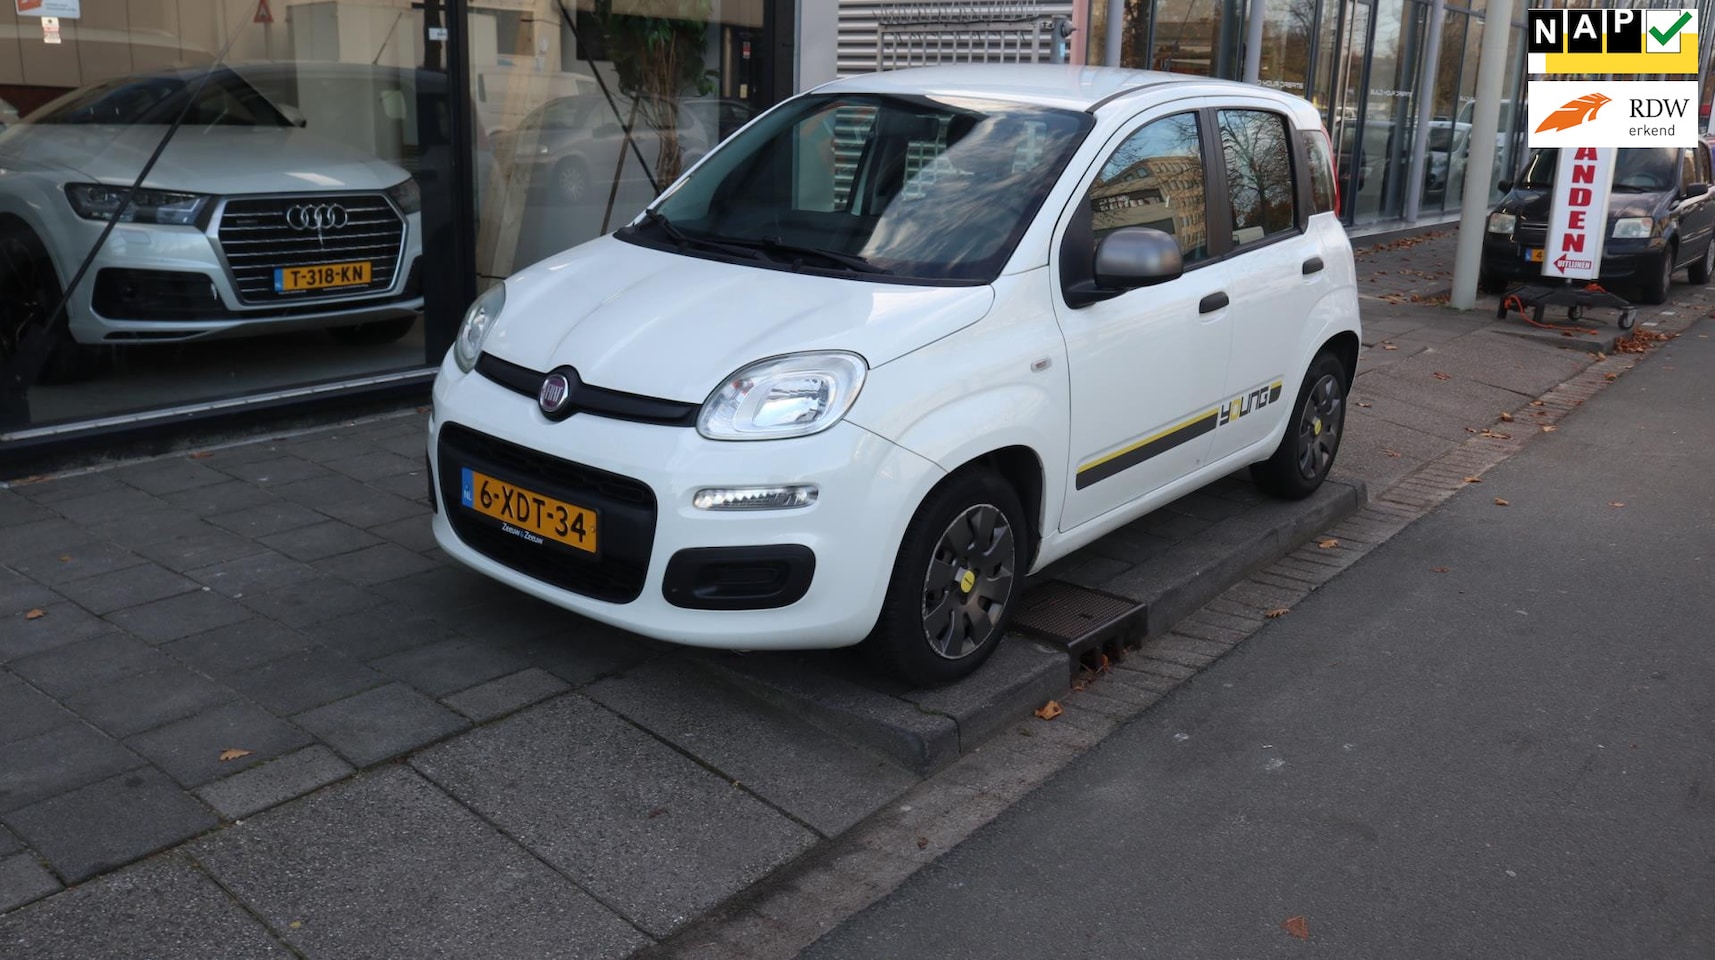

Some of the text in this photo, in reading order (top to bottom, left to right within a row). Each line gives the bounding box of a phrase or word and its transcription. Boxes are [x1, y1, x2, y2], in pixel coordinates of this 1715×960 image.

[290, 265, 363, 287] T-318-KN
[1219, 386, 1269, 426] YOUNG
[480, 480, 587, 543] 6-XDT-34
